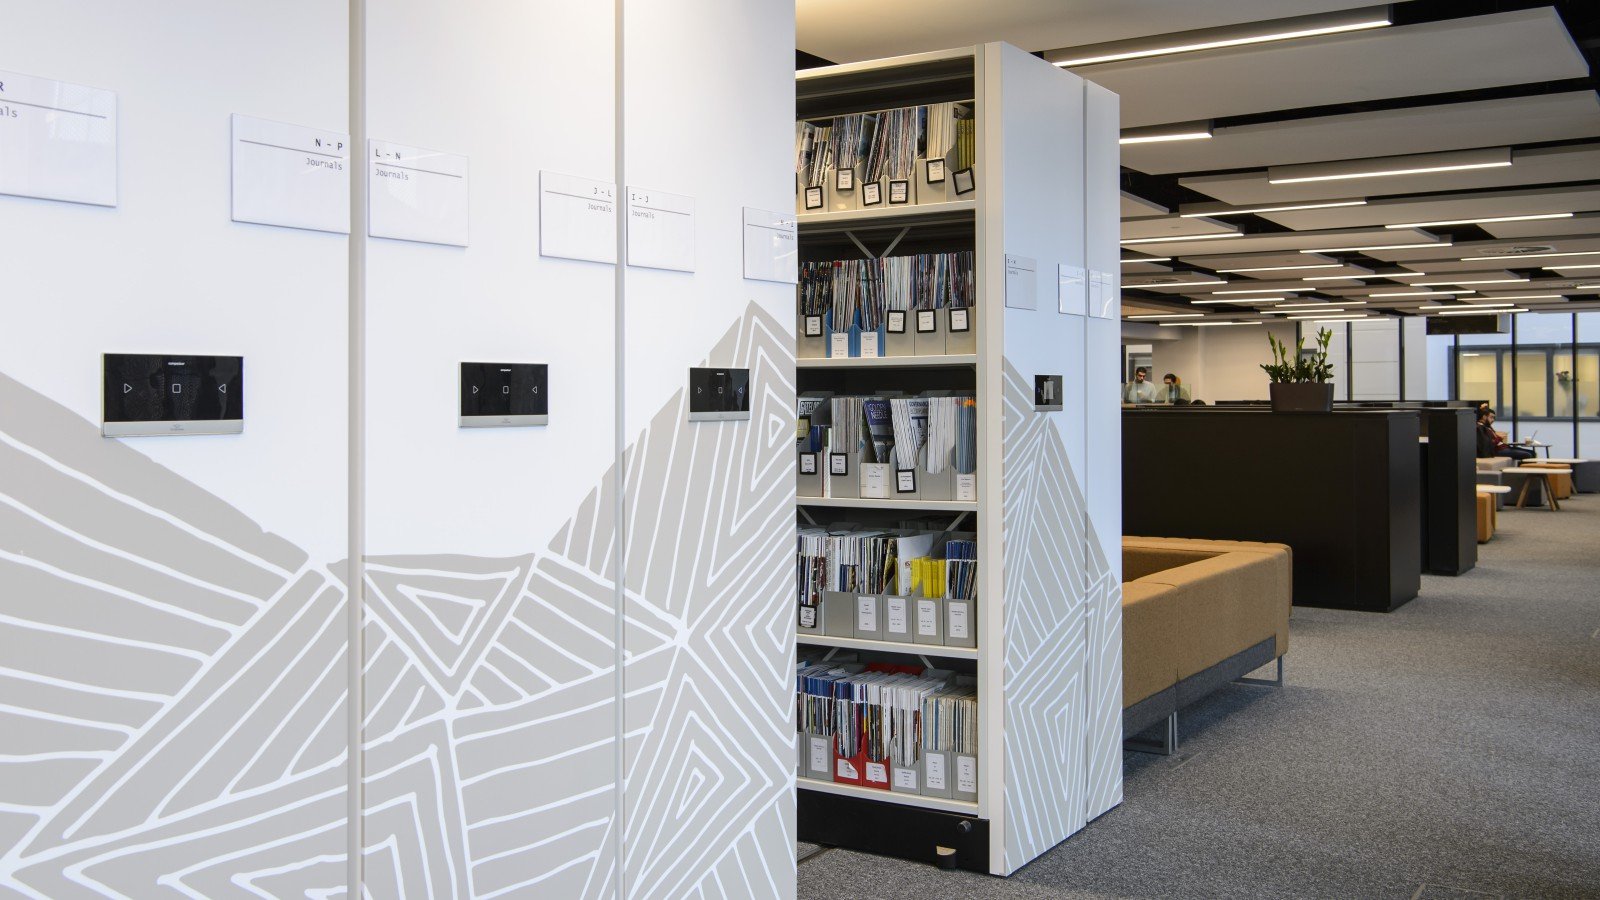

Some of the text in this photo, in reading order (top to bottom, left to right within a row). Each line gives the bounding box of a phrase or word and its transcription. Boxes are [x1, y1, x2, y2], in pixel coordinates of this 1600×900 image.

[315, 138, 321, 148] N
[337, 142, 343, 151] P
[375, 148, 381, 158] L
[395, 152, 401, 161] N
[305, 157, 343, 171] Journals
[375, 168, 409, 181] Journals
[587, 202, 612, 213] Journals
[631, 209, 655, 219] Journals
